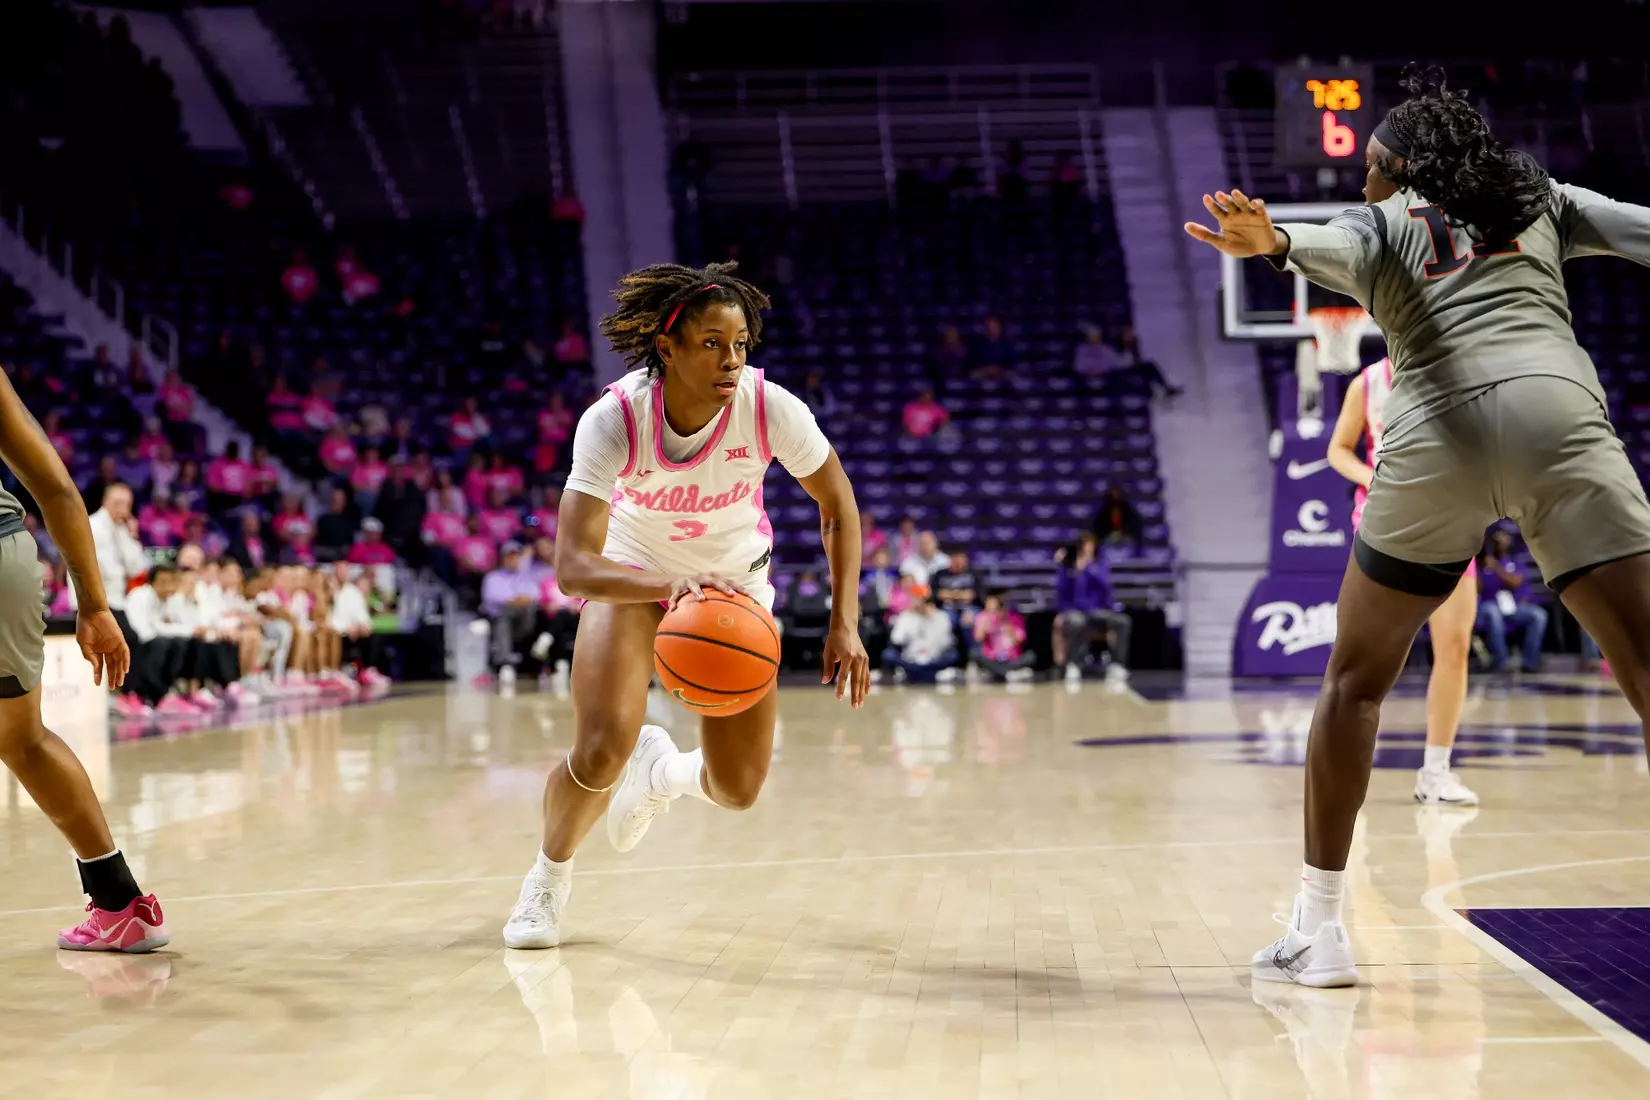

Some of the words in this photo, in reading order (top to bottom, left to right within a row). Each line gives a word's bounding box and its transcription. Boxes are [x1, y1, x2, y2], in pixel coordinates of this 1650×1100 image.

[1322, 110, 1355, 157] 6
[724, 445, 750, 462] XII
[624, 479, 751, 513] Wildcats
[668, 519, 708, 542] 3
